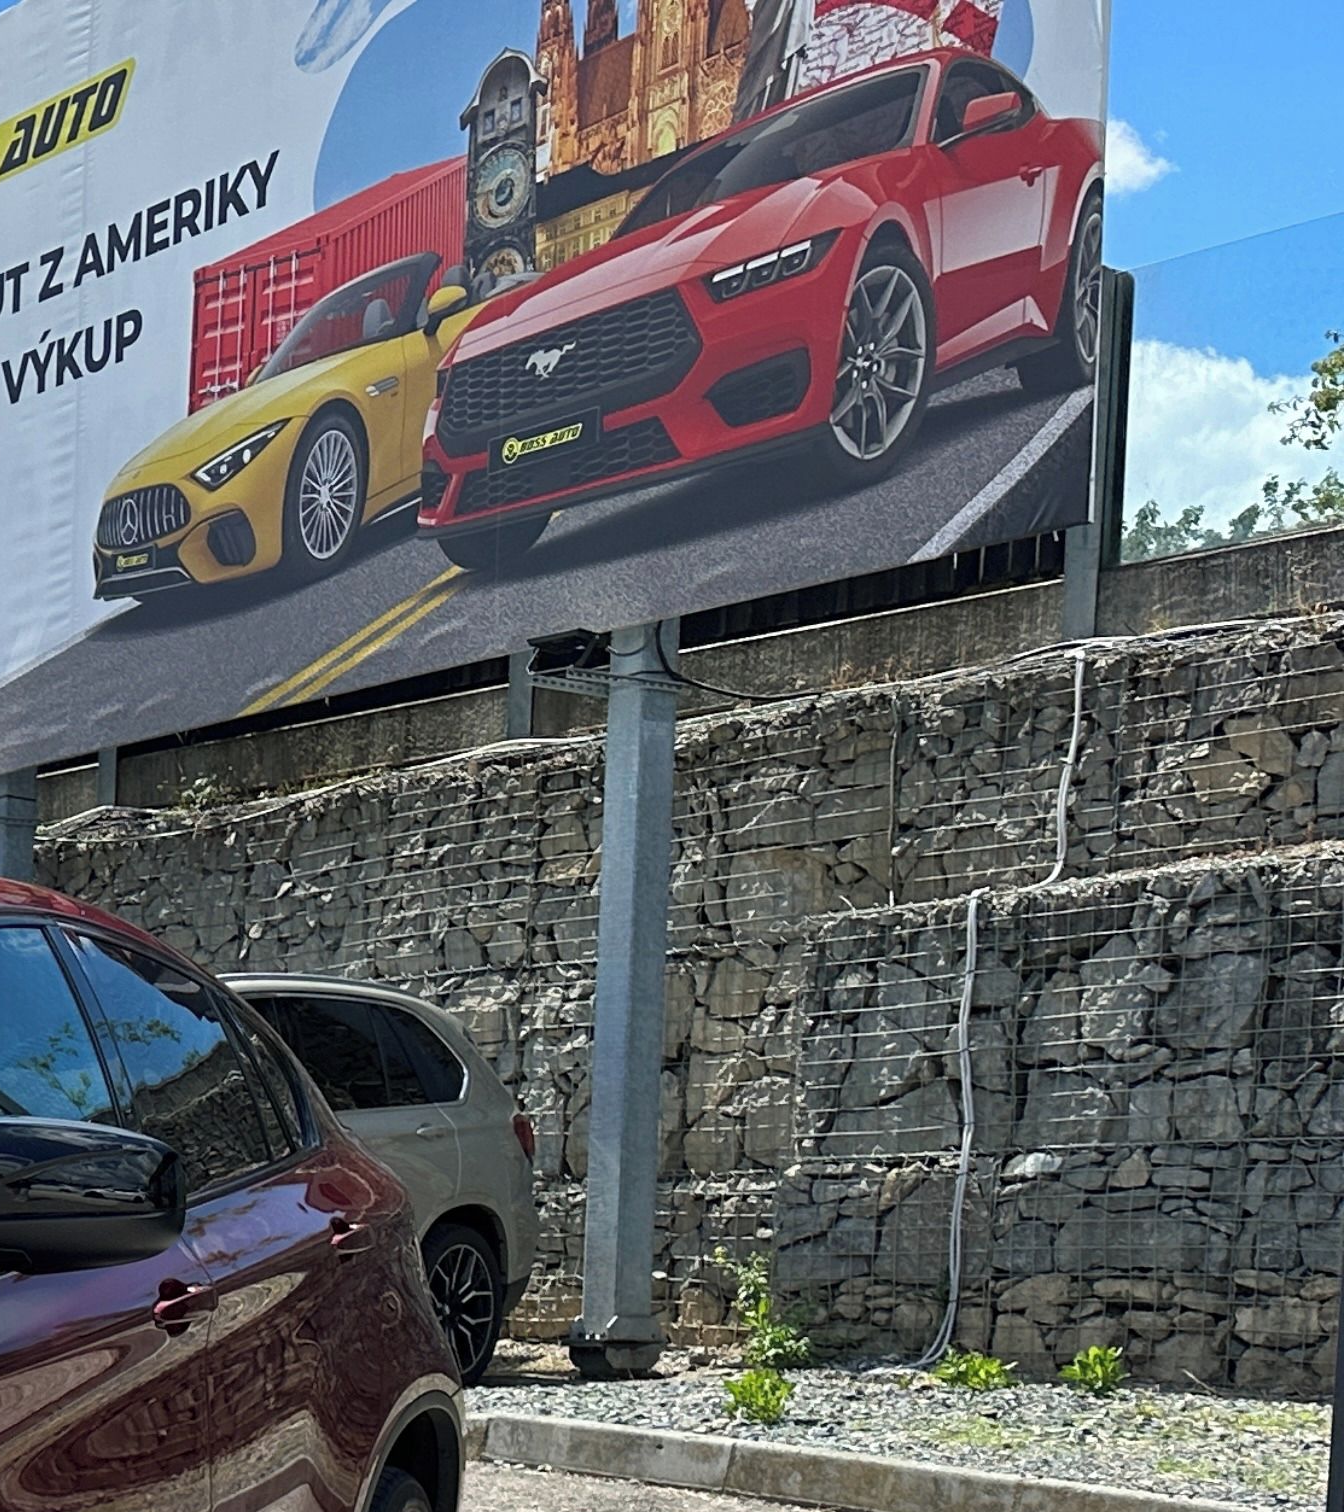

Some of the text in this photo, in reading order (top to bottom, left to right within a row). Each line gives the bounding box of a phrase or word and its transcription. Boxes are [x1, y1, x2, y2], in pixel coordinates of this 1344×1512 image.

[38, 246, 64, 303] Z
[73, 149, 279, 288] AMERIKY
[1, 308, 143, 405] VÝKUP
